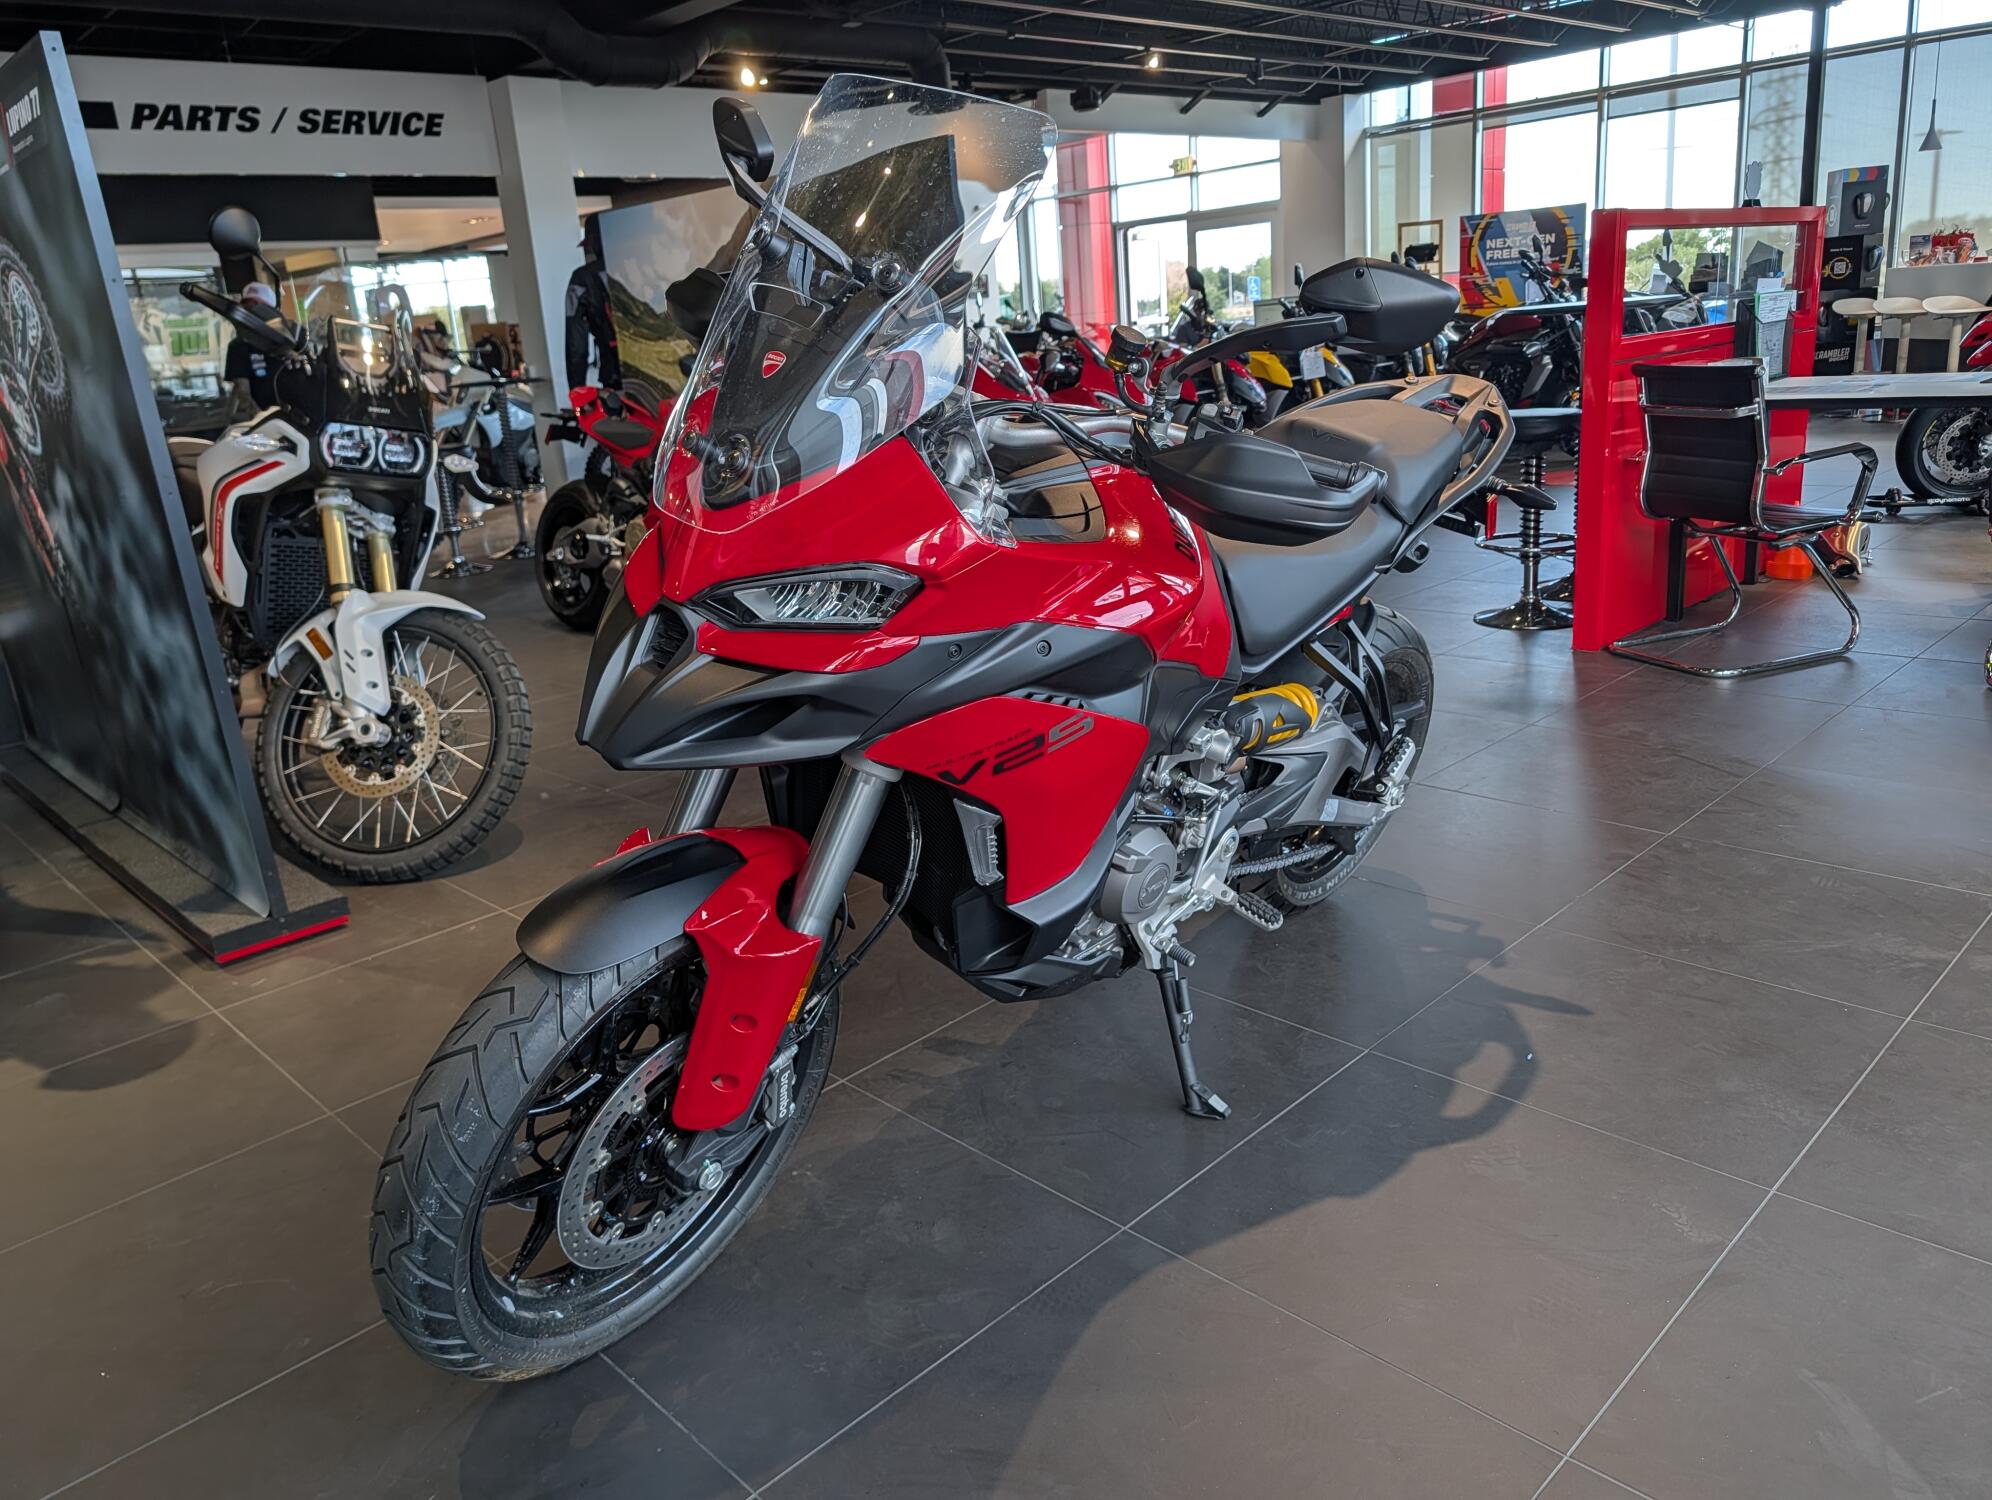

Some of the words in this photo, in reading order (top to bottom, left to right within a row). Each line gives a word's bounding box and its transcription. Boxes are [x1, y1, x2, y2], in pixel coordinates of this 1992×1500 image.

[130, 103, 261, 133] PARTS
[271, 106, 288, 134] /
[297, 108, 444, 137] SERVICE
[1486, 245, 1552, 260] FREEM
[1814, 347, 1851, 360] CRAMBLER
[779, 1069, 791, 1118] brembo
